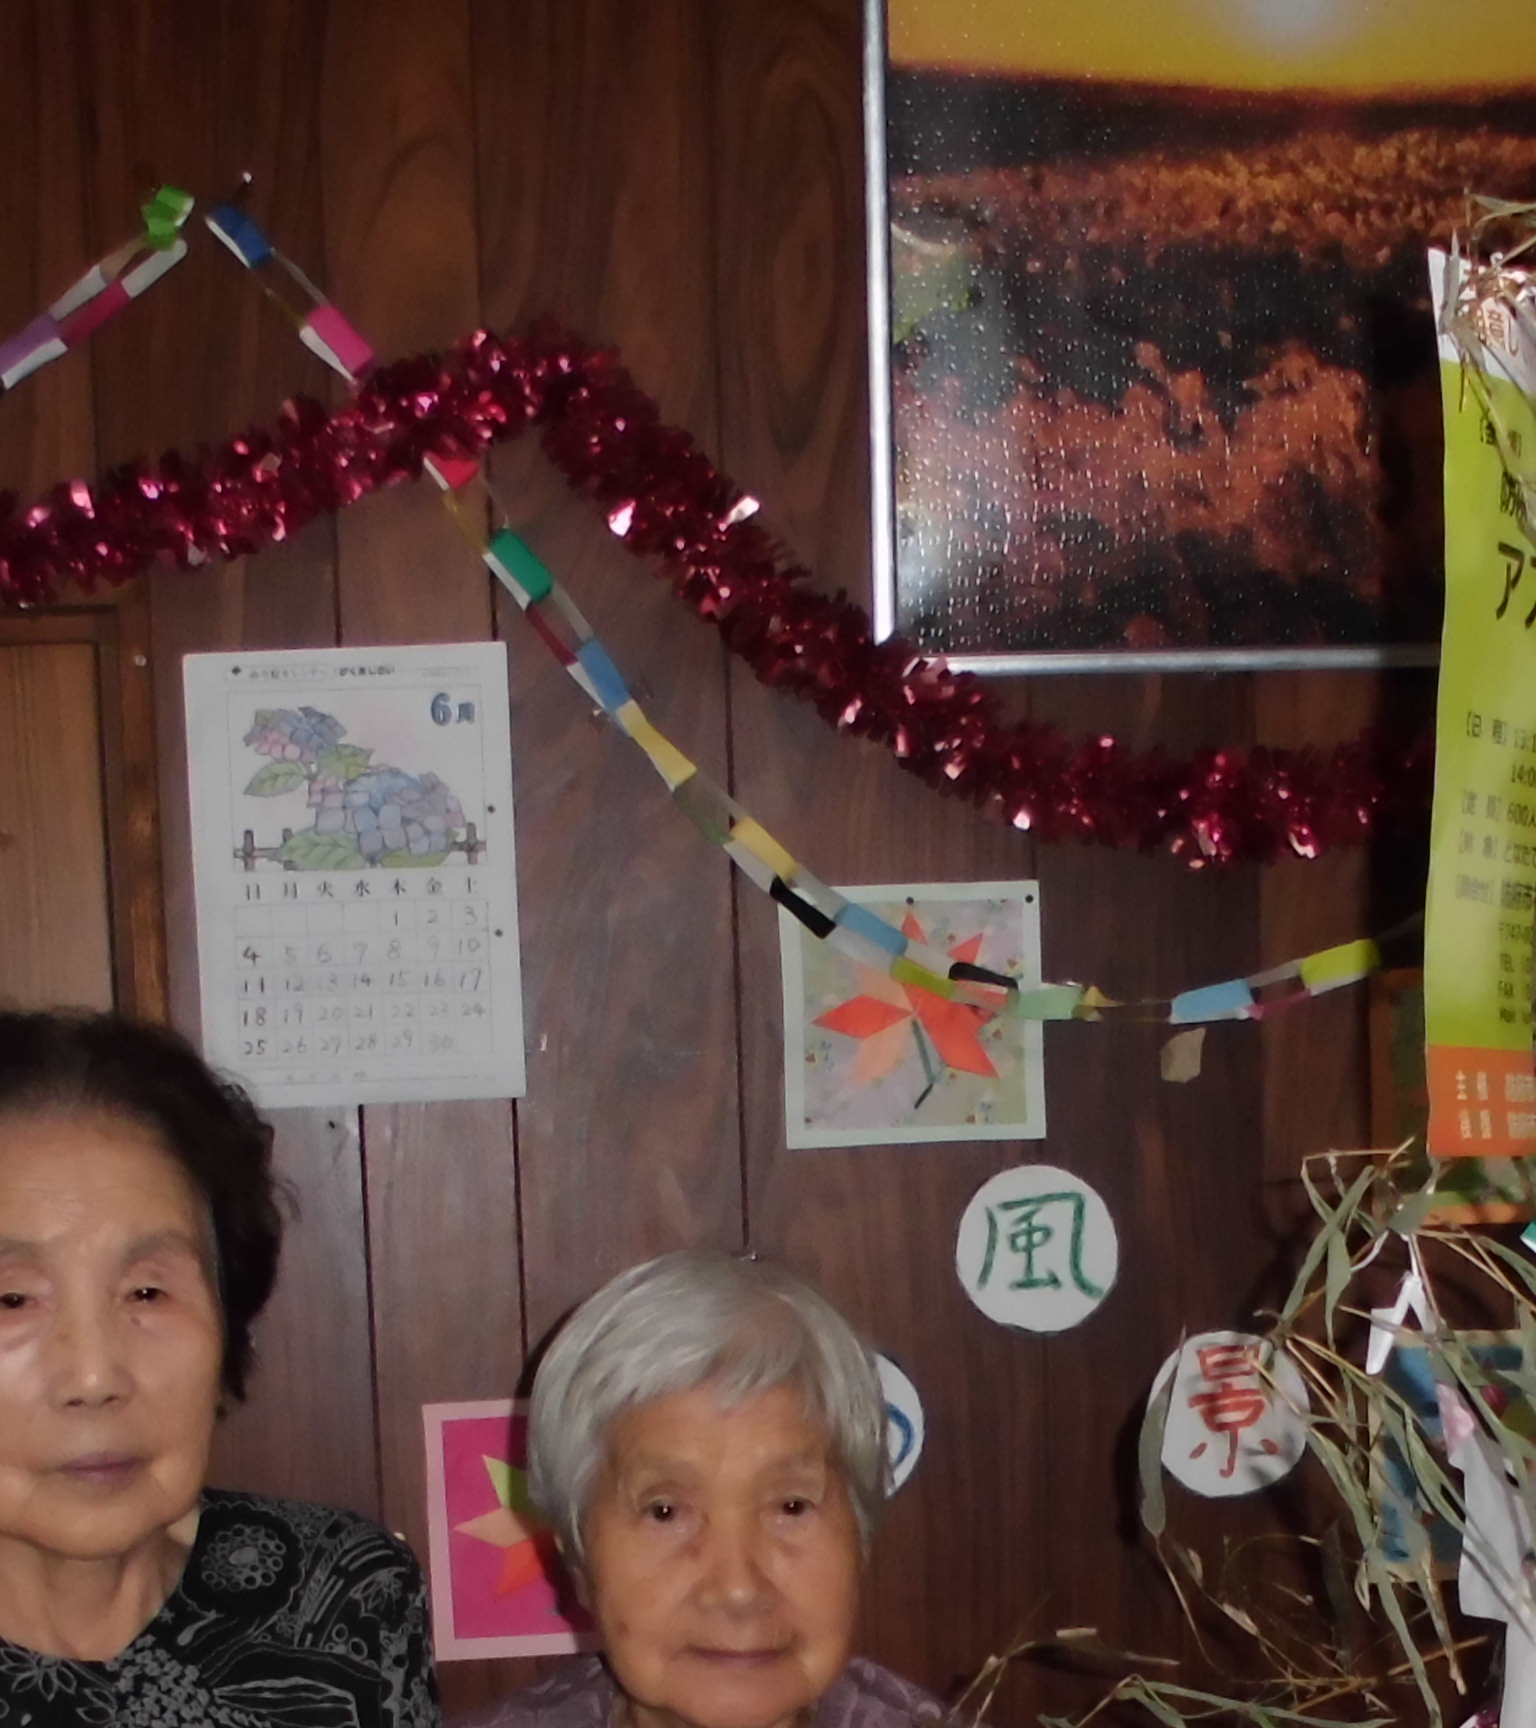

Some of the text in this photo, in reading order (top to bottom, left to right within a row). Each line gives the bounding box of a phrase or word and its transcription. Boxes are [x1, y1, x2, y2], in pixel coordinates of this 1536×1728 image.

[317, 880, 334, 899] 火
[354, 879, 371, 897] 水
[391, 877, 407, 895] 木
[427, 909, 439, 925] 2
[463, 905, 479, 926] 3
[241, 936, 481, 969] 4 5 6 7 8 9 10
[244, 975, 265, 993] 11
[285, 976, 305, 992] 12
[352, 972, 373, 989] 14
[389, 970, 410, 987] 15
[423, 970, 446, 988] 16
[459, 967, 482, 992] 17
[242, 1002, 487, 1027] 18 19 20 21 22 23 24
[244, 1039, 267, 1056] 25
[282, 1036, 307, 1054] 26
[320, 1035, 342, 1054] 27
[355, 1033, 377, 1051] 28
[392, 1028, 414, 1049] 29
[976, 1191, 1104, 1300] 風
[1188, 1344, 1280, 1479] 景
